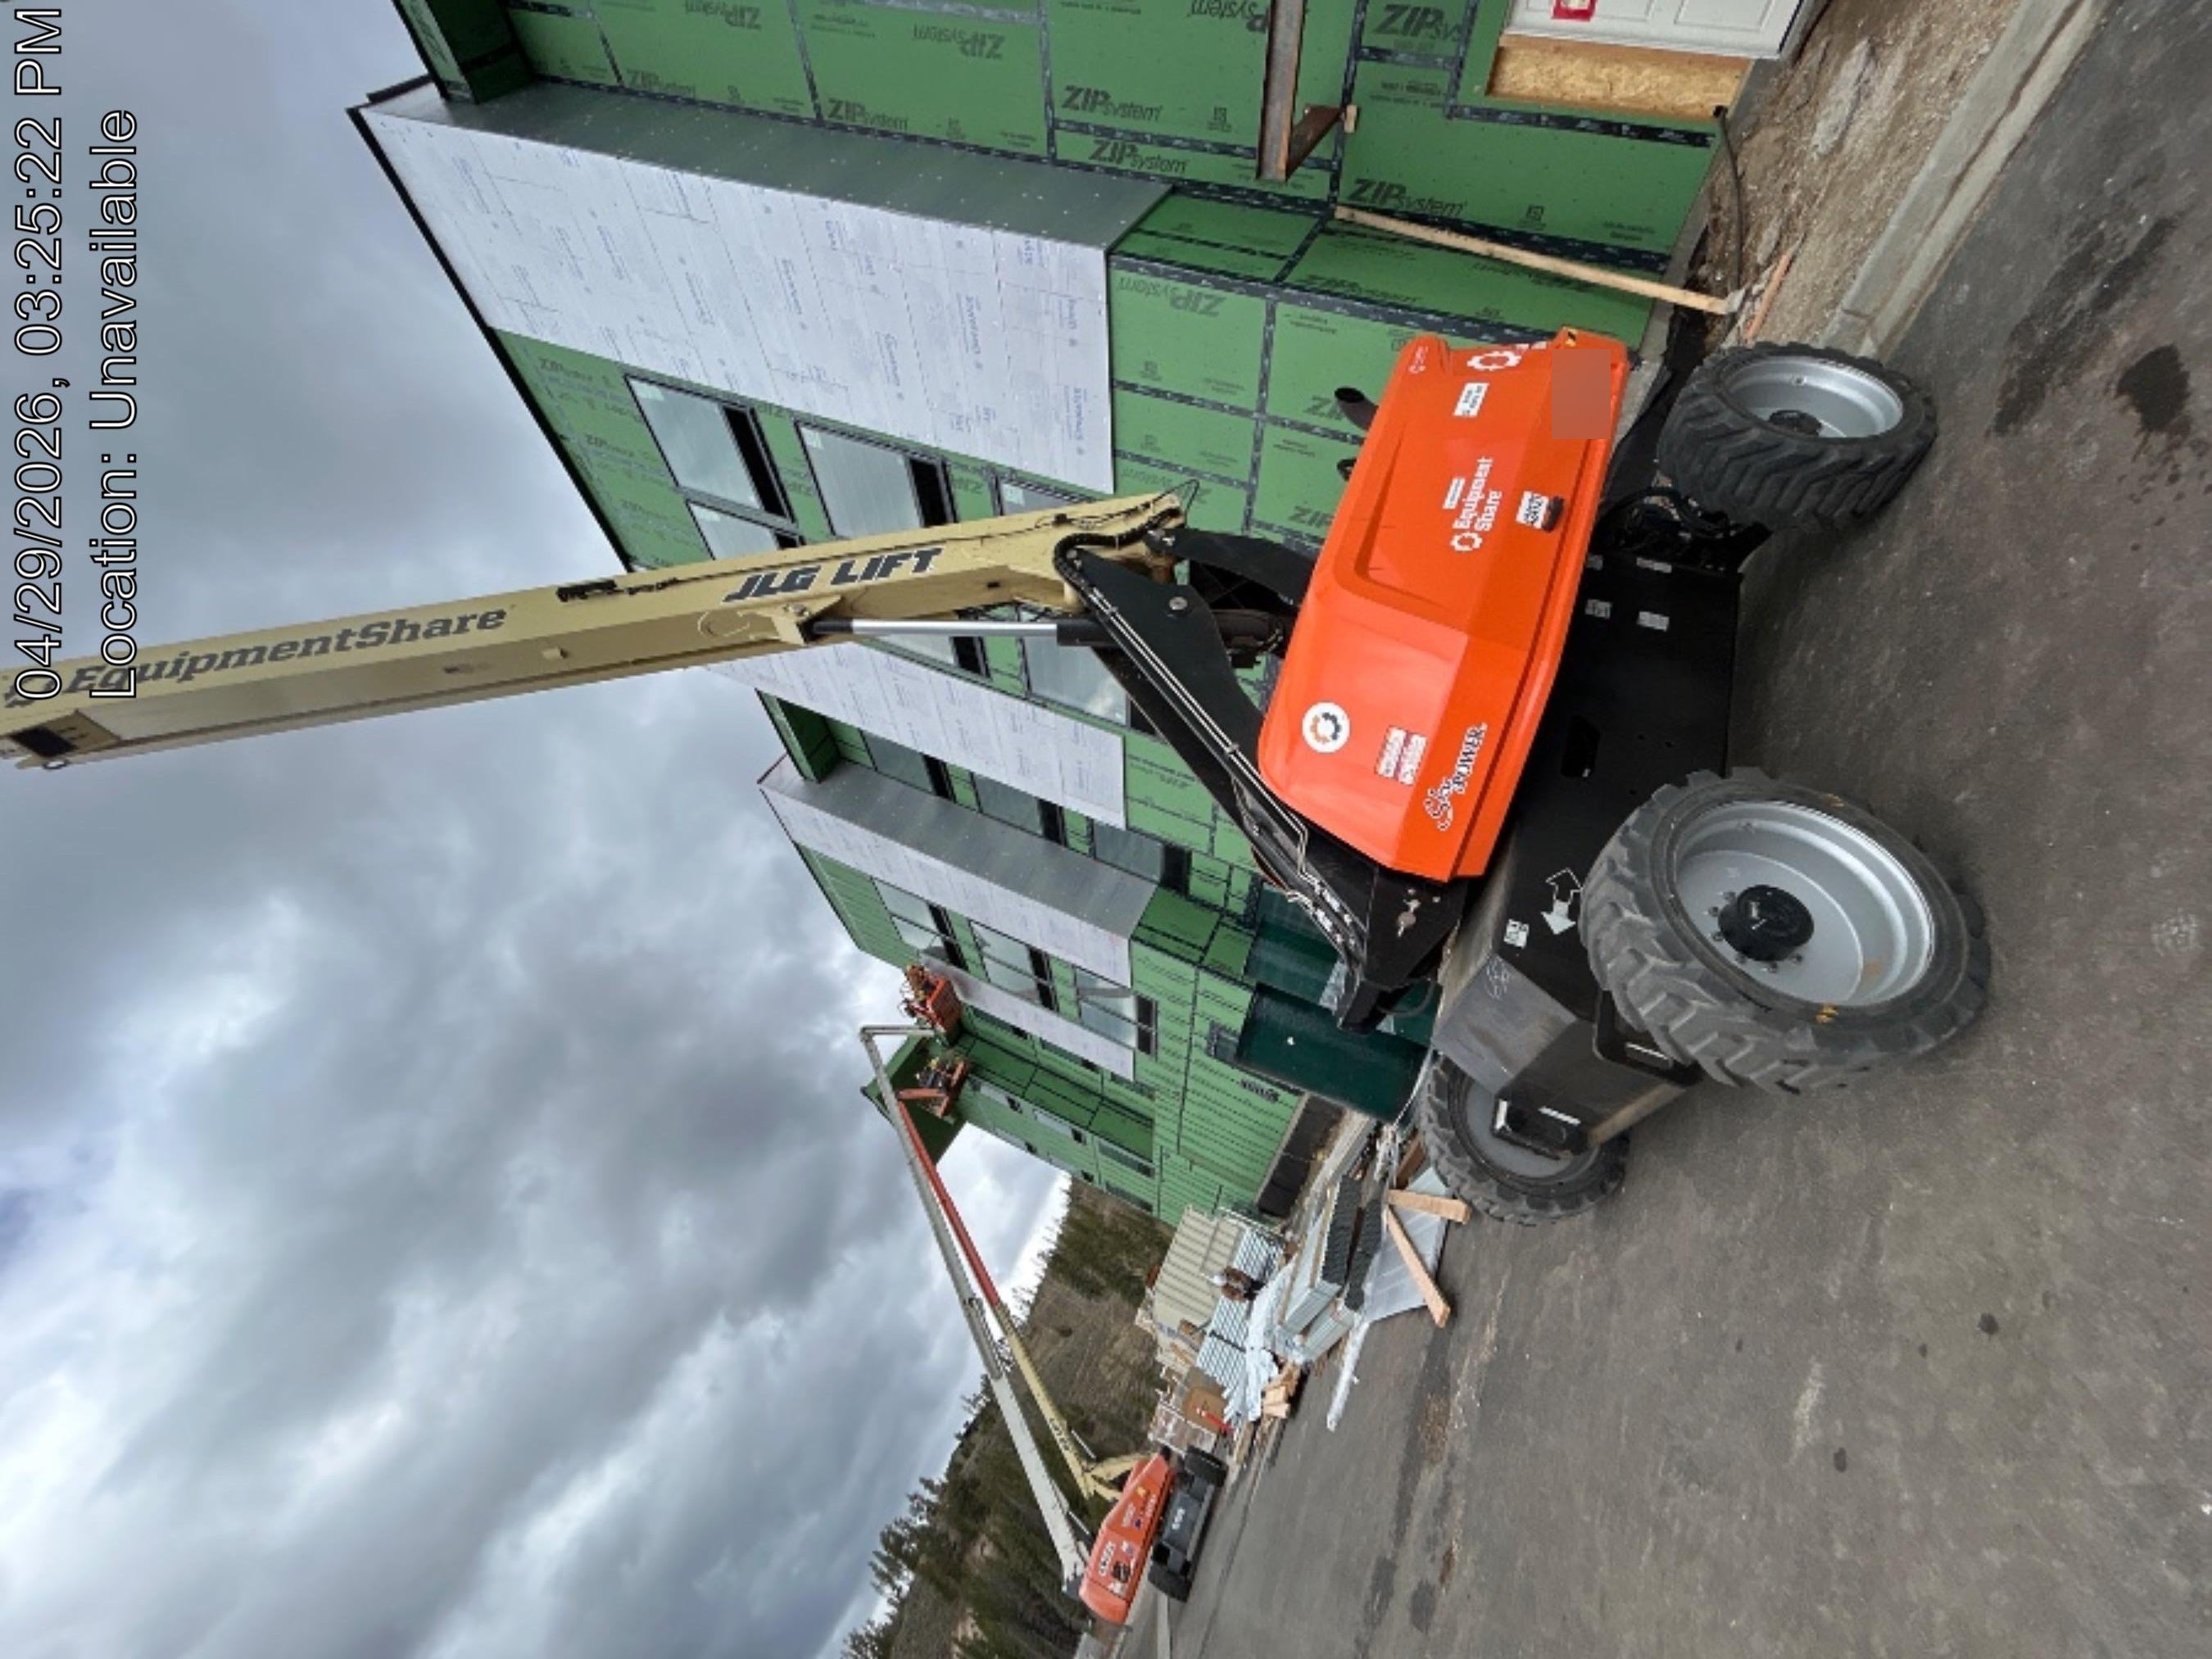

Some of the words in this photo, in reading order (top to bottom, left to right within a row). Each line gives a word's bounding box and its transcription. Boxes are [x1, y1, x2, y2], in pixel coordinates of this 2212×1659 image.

[1453, 456, 1494, 529] Equipment
[1474, 491, 1503, 532] Share
[721, 565, 822, 604] JLG
[830, 547, 943, 586] LIFT
[62, 609, 507, 694] EquipmentShare
